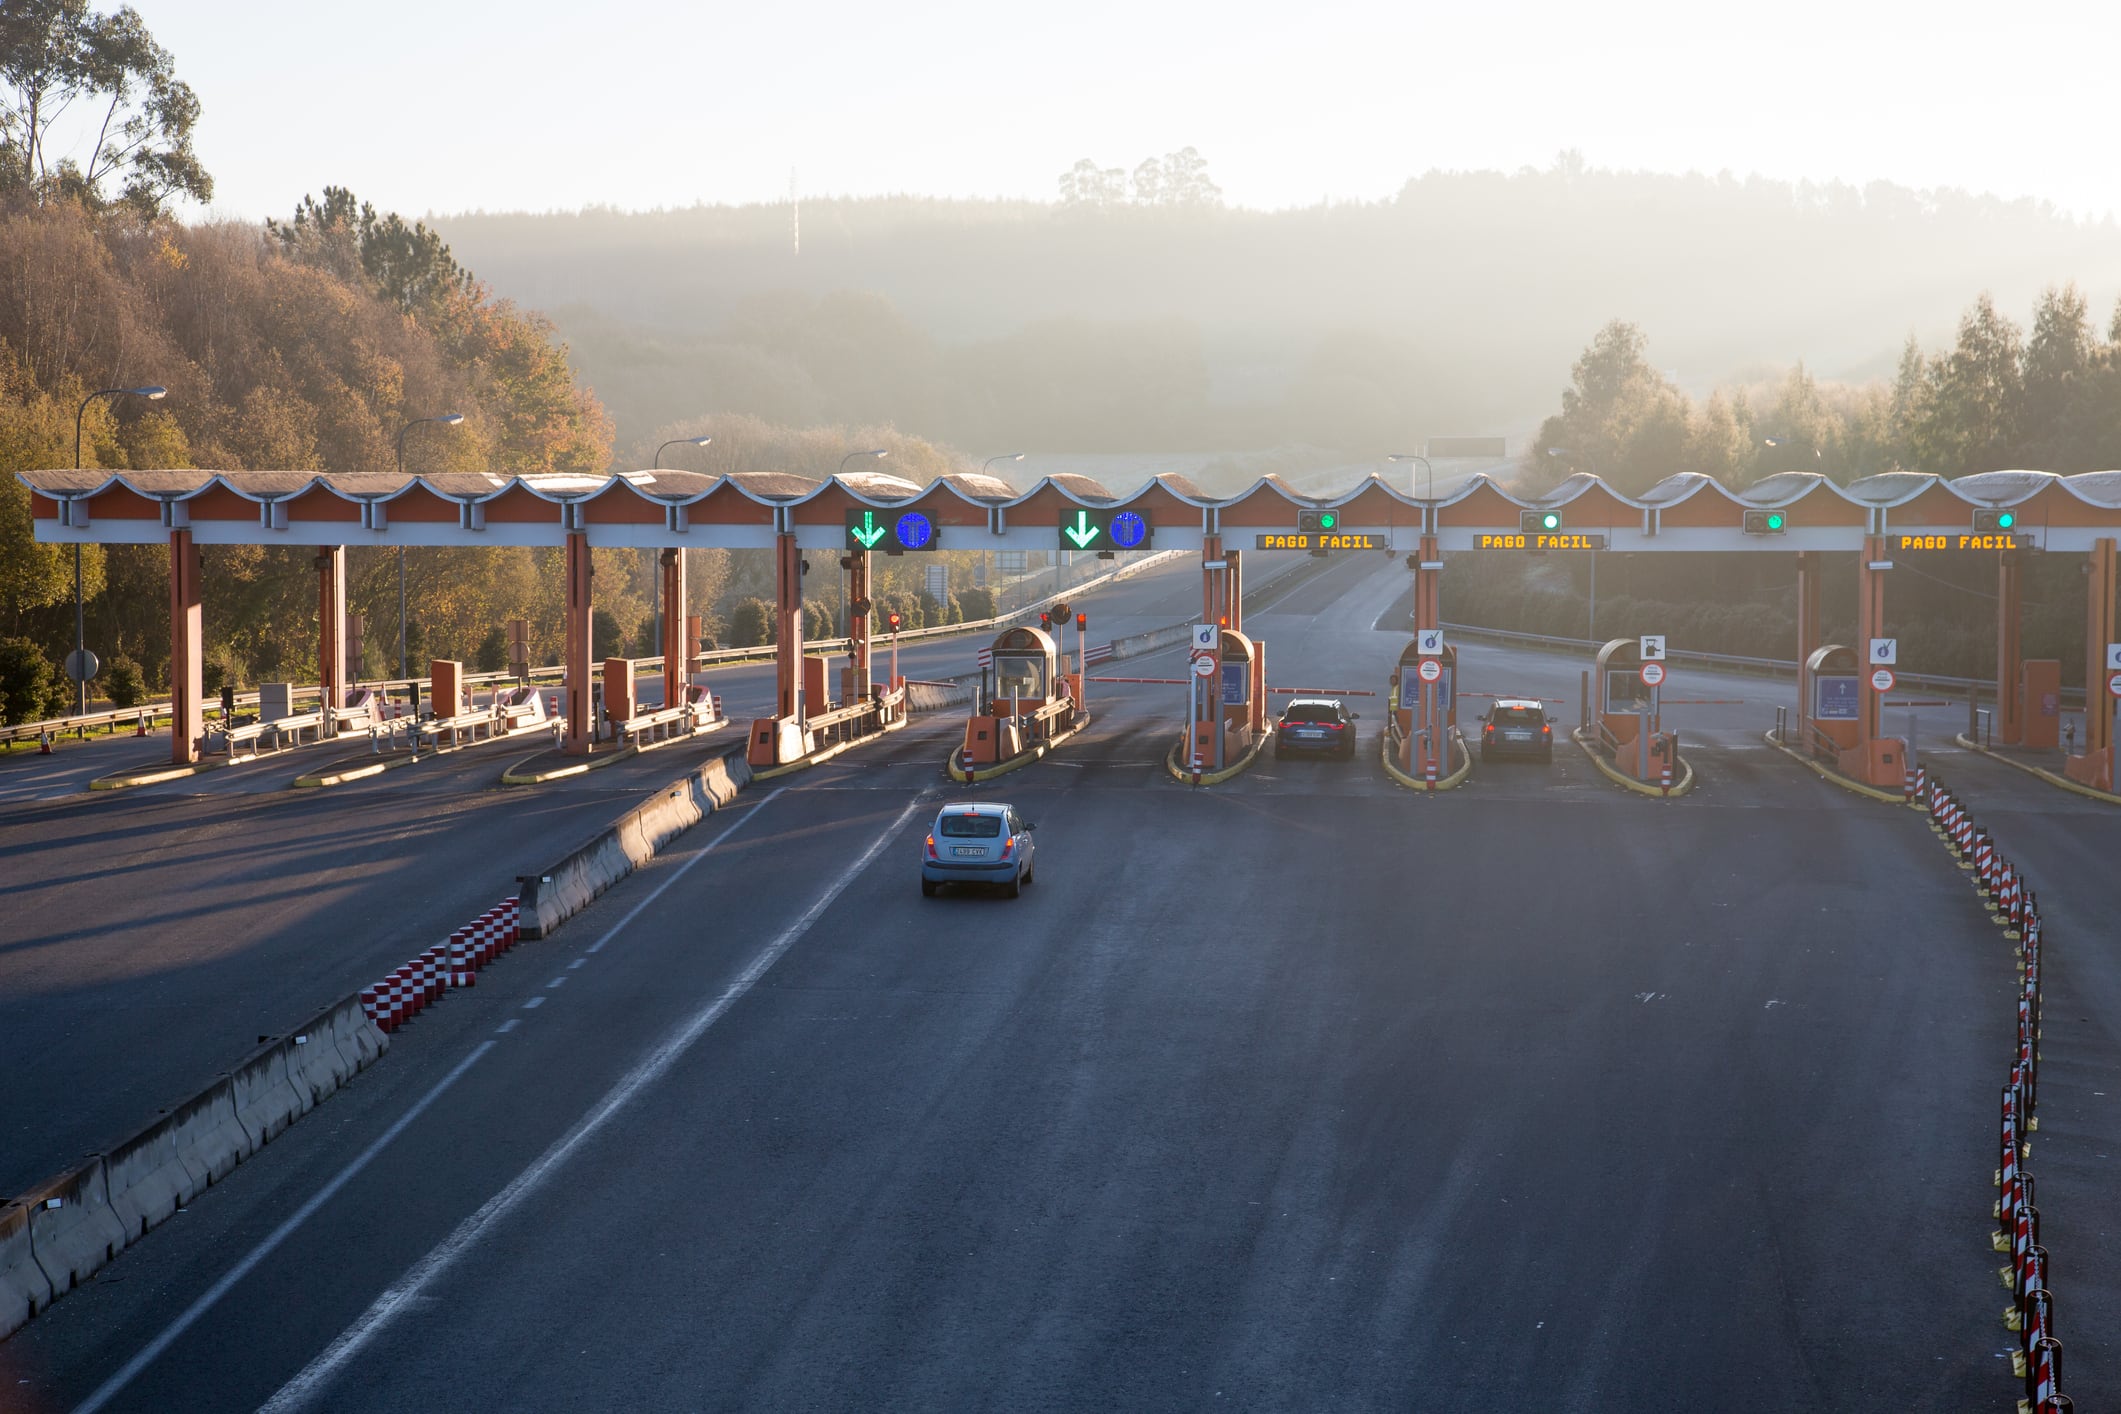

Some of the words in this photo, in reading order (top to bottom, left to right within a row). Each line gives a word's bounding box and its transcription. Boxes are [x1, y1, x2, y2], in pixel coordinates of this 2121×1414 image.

[1265, 535, 1308, 549] PAGO
[1319, 535, 1373, 549] FACIL
[1481, 535, 1526, 549] PAGO
[1537, 535, 1592, 549] FACIL
[1901, 536, 1947, 550] PAGO
[1959, 536, 2017, 550] FACIL
